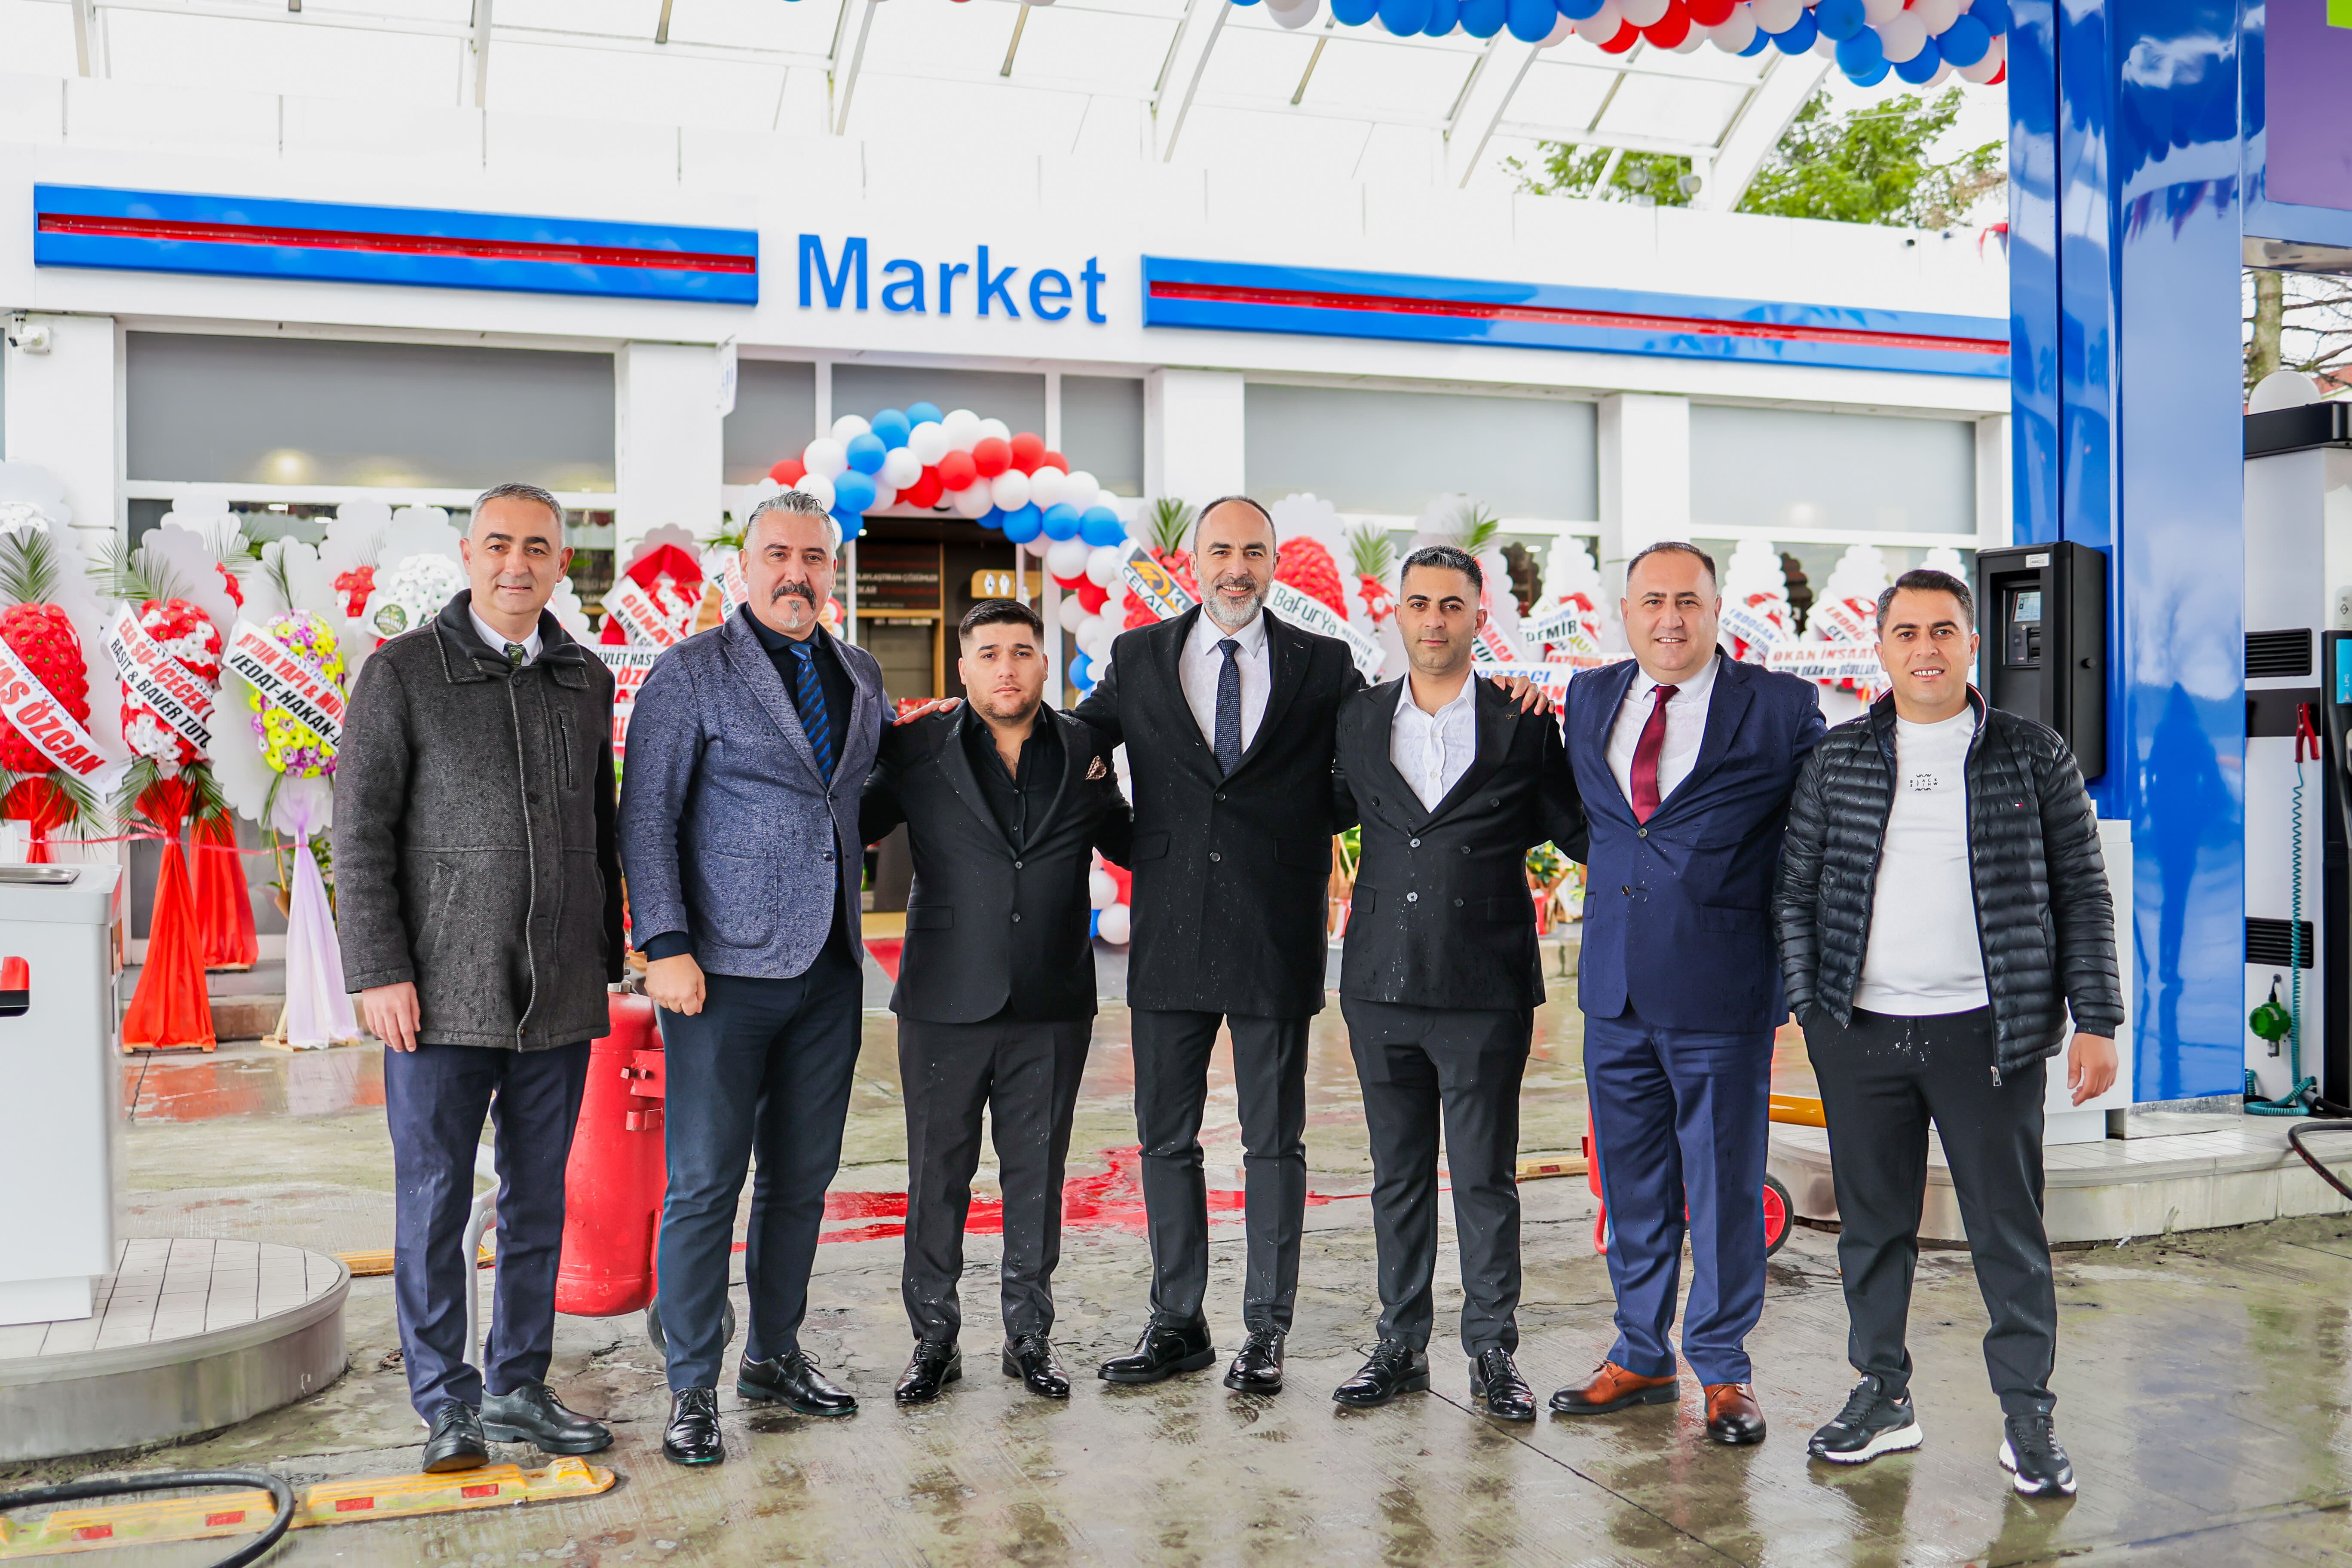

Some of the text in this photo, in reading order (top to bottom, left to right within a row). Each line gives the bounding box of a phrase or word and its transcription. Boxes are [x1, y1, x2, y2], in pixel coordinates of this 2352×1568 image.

[798, 234, 1107, 323] Market
[1122, 567, 1162, 616] CELAL
[119, 617, 138, 646] EKO
[1521, 620, 1577, 642] DEMİR
[1773, 649, 1816, 662] OKAN
[236, 633, 281, 665] AYDIN
[274, 658, 311, 689] YAPI
[303, 685, 319, 699] &
[594, 652, 628, 665] EVLET
[127, 671, 138, 683] &
[136, 679, 183, 720] BAVER
[16, 699, 107, 776] ÖZCAN
